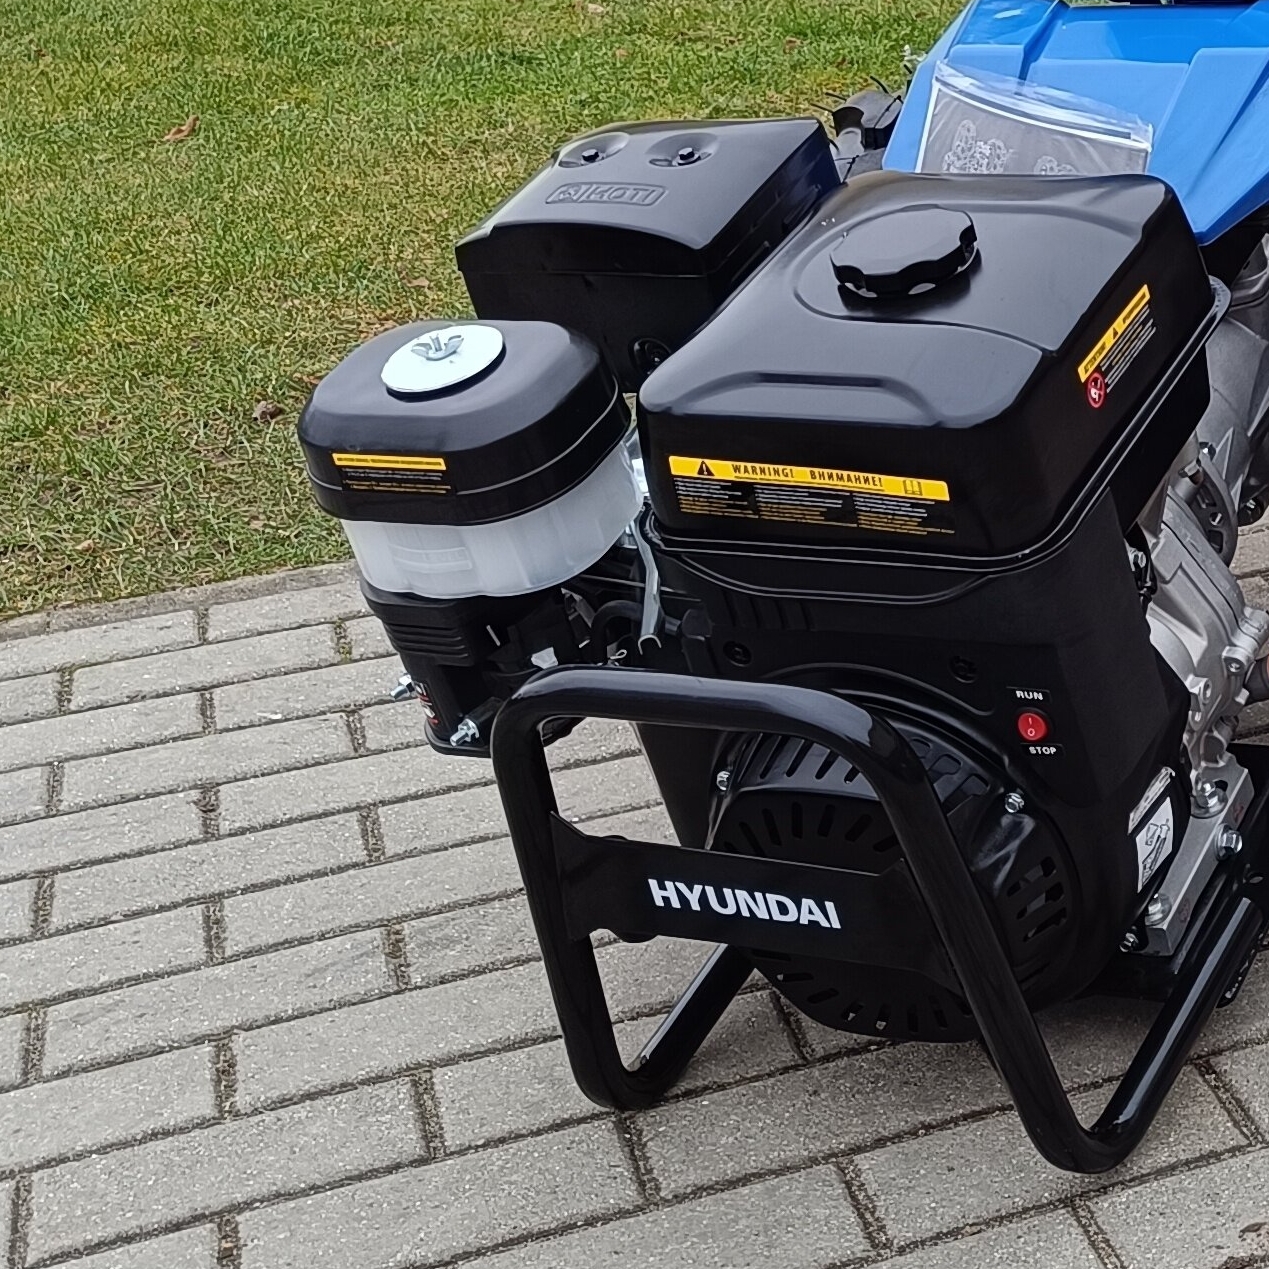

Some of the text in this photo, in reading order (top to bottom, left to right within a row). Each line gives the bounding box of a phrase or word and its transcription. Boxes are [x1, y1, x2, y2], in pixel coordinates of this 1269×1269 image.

[731, 463, 794, 479] WARNING!
[1015, 690, 1044, 700] RUN
[1028, 746, 1057, 755] STOP
[648, 878, 841, 929] HYUNDAI
